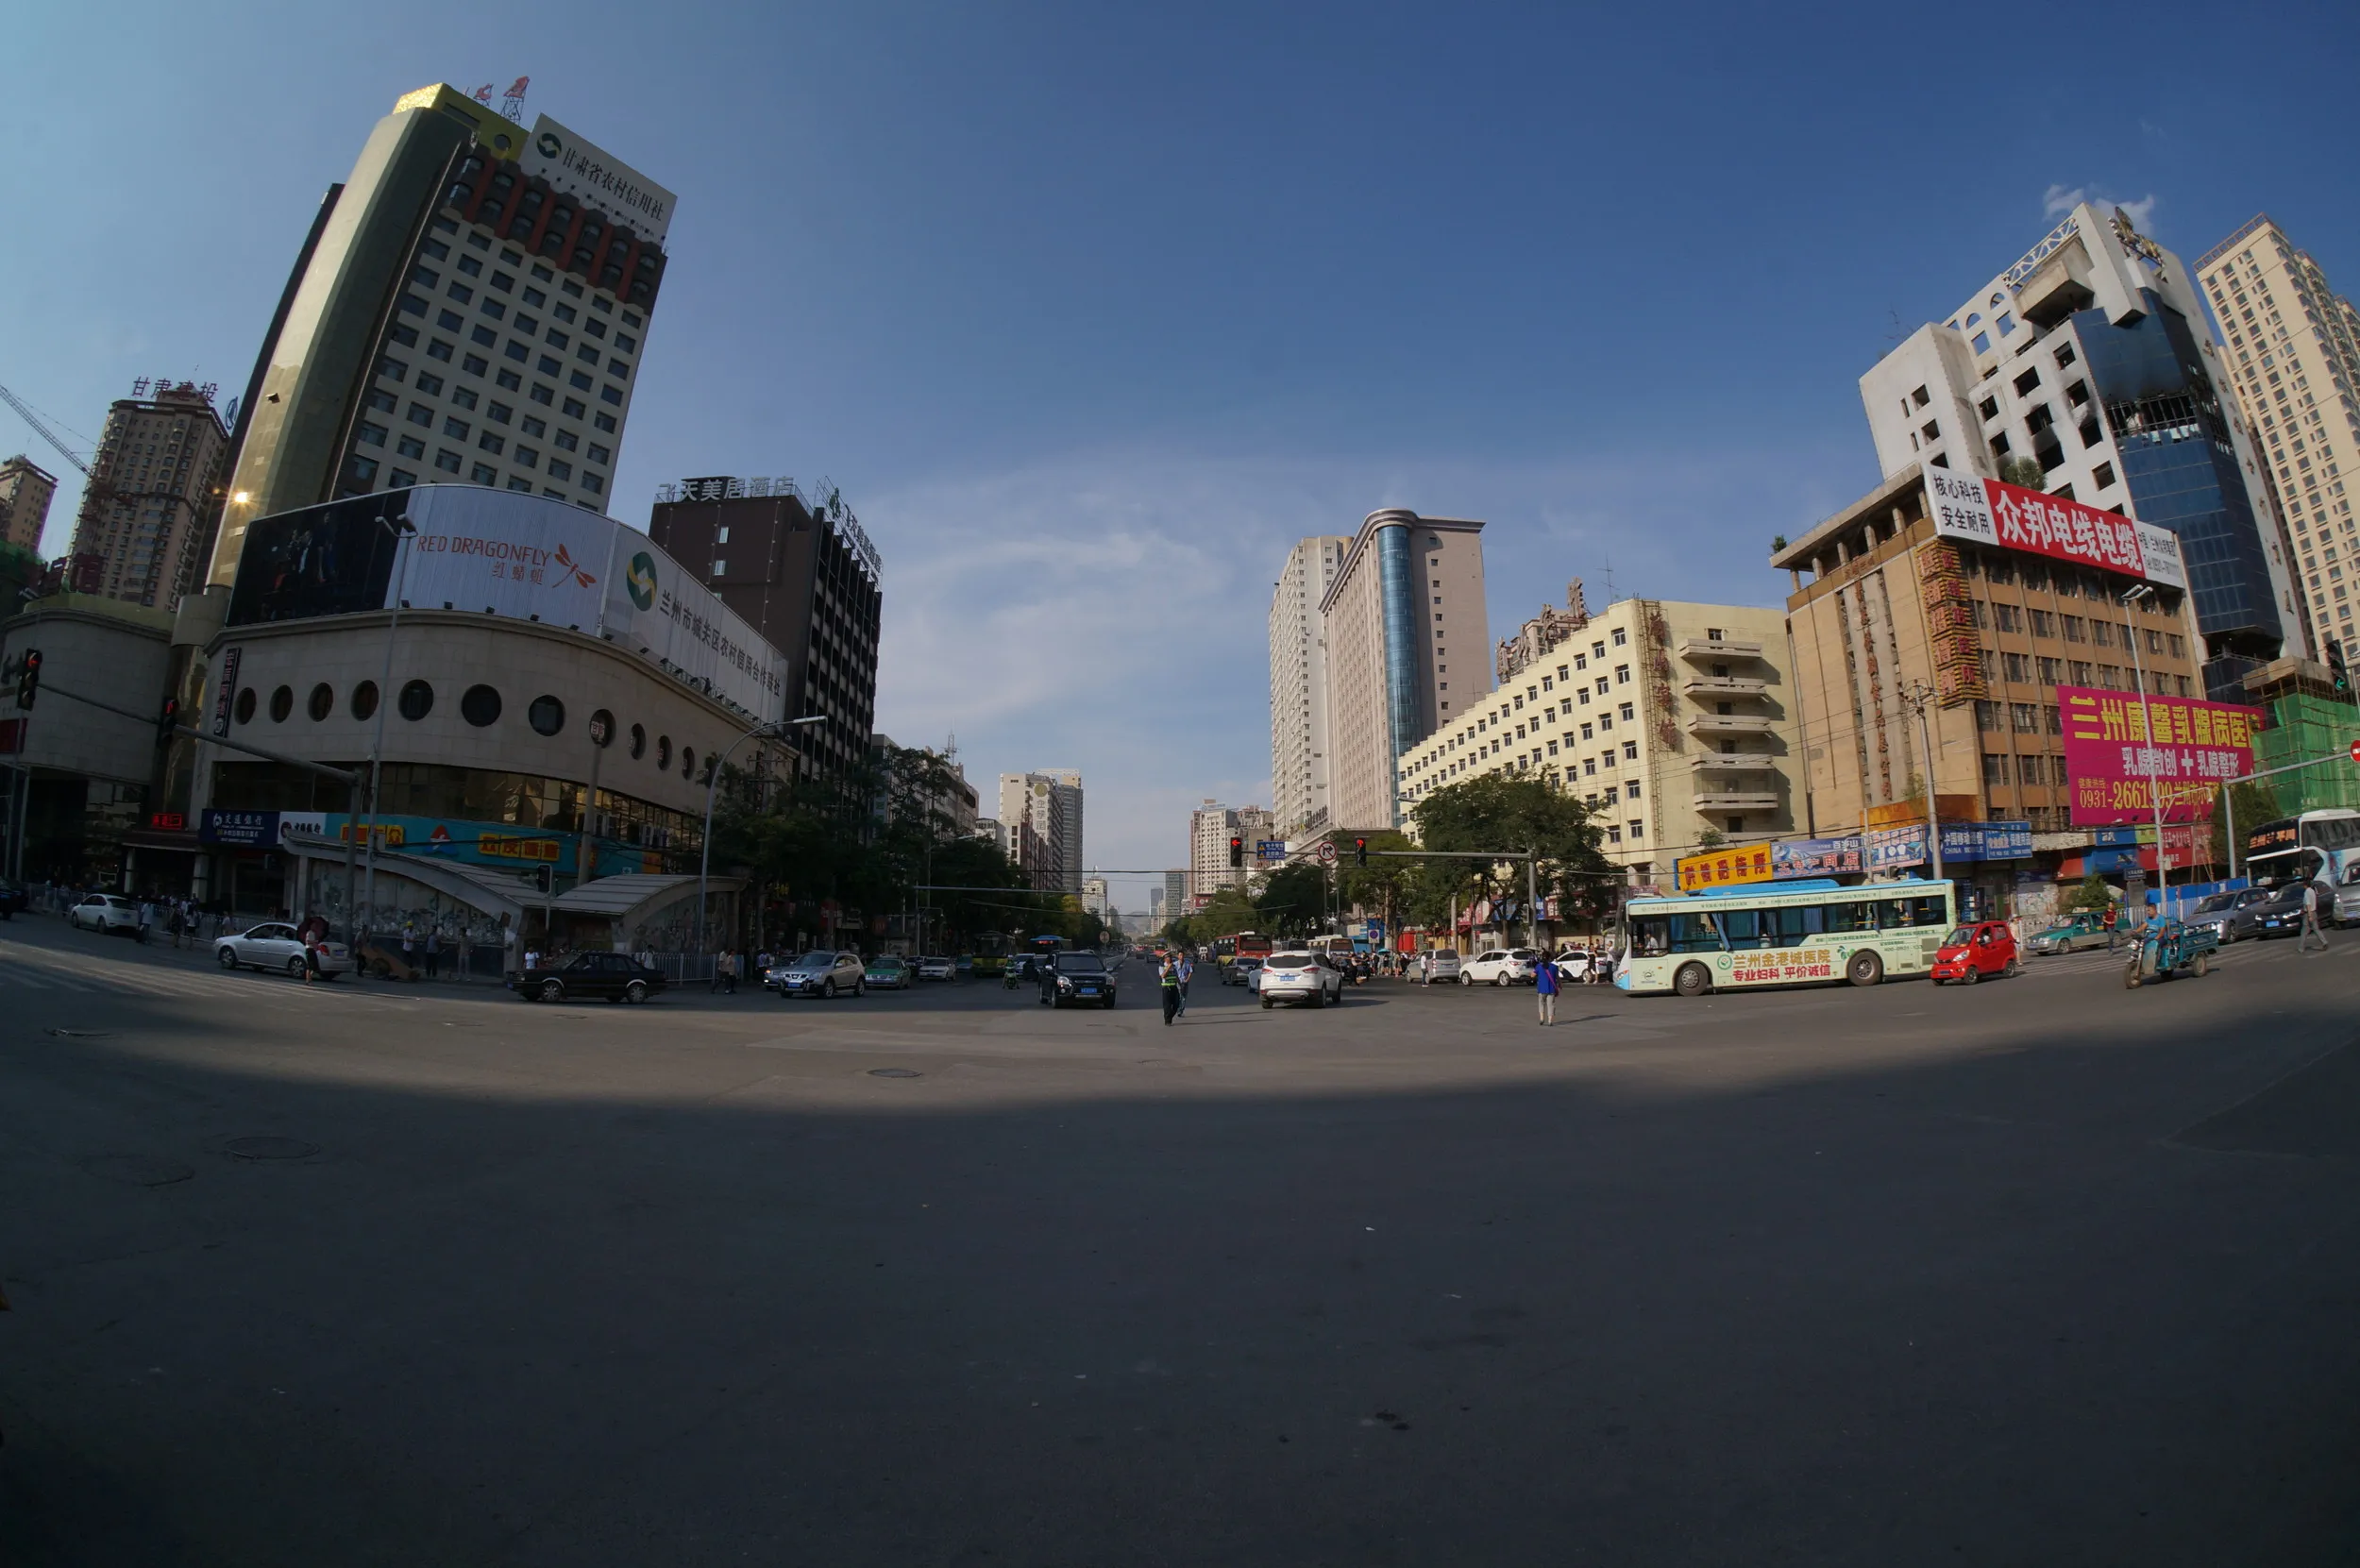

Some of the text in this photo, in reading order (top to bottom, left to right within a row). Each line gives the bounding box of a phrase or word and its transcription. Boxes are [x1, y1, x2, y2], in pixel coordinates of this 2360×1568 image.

[563, 146, 665, 222] 甘肃省农村信用社
[131, 376, 218, 403] 甘肃建投
[659, 476, 794, 504] 飞天美居酒店
[1933, 474, 1984, 506] 核心科技
[1941, 505, 1991, 535] 安全耐用
[1995, 489, 2144, 573] 众邦电线电缆
[416, 535, 551, 566] RED DRAGONFLY
[492, 561, 545, 585] 红蜻蜓
[2121, 746, 2178, 777] 乳腺微创
[2196, 750, 2239, 778] 乳腺整形
[225, 813, 263, 825] 交通银行
[1945, 831, 1983, 846] 中国移动通信
[1732, 964, 1830, 982] 专业妇科 平价诚信
[1733, 949, 1830, 969] 兰州金港城医院
